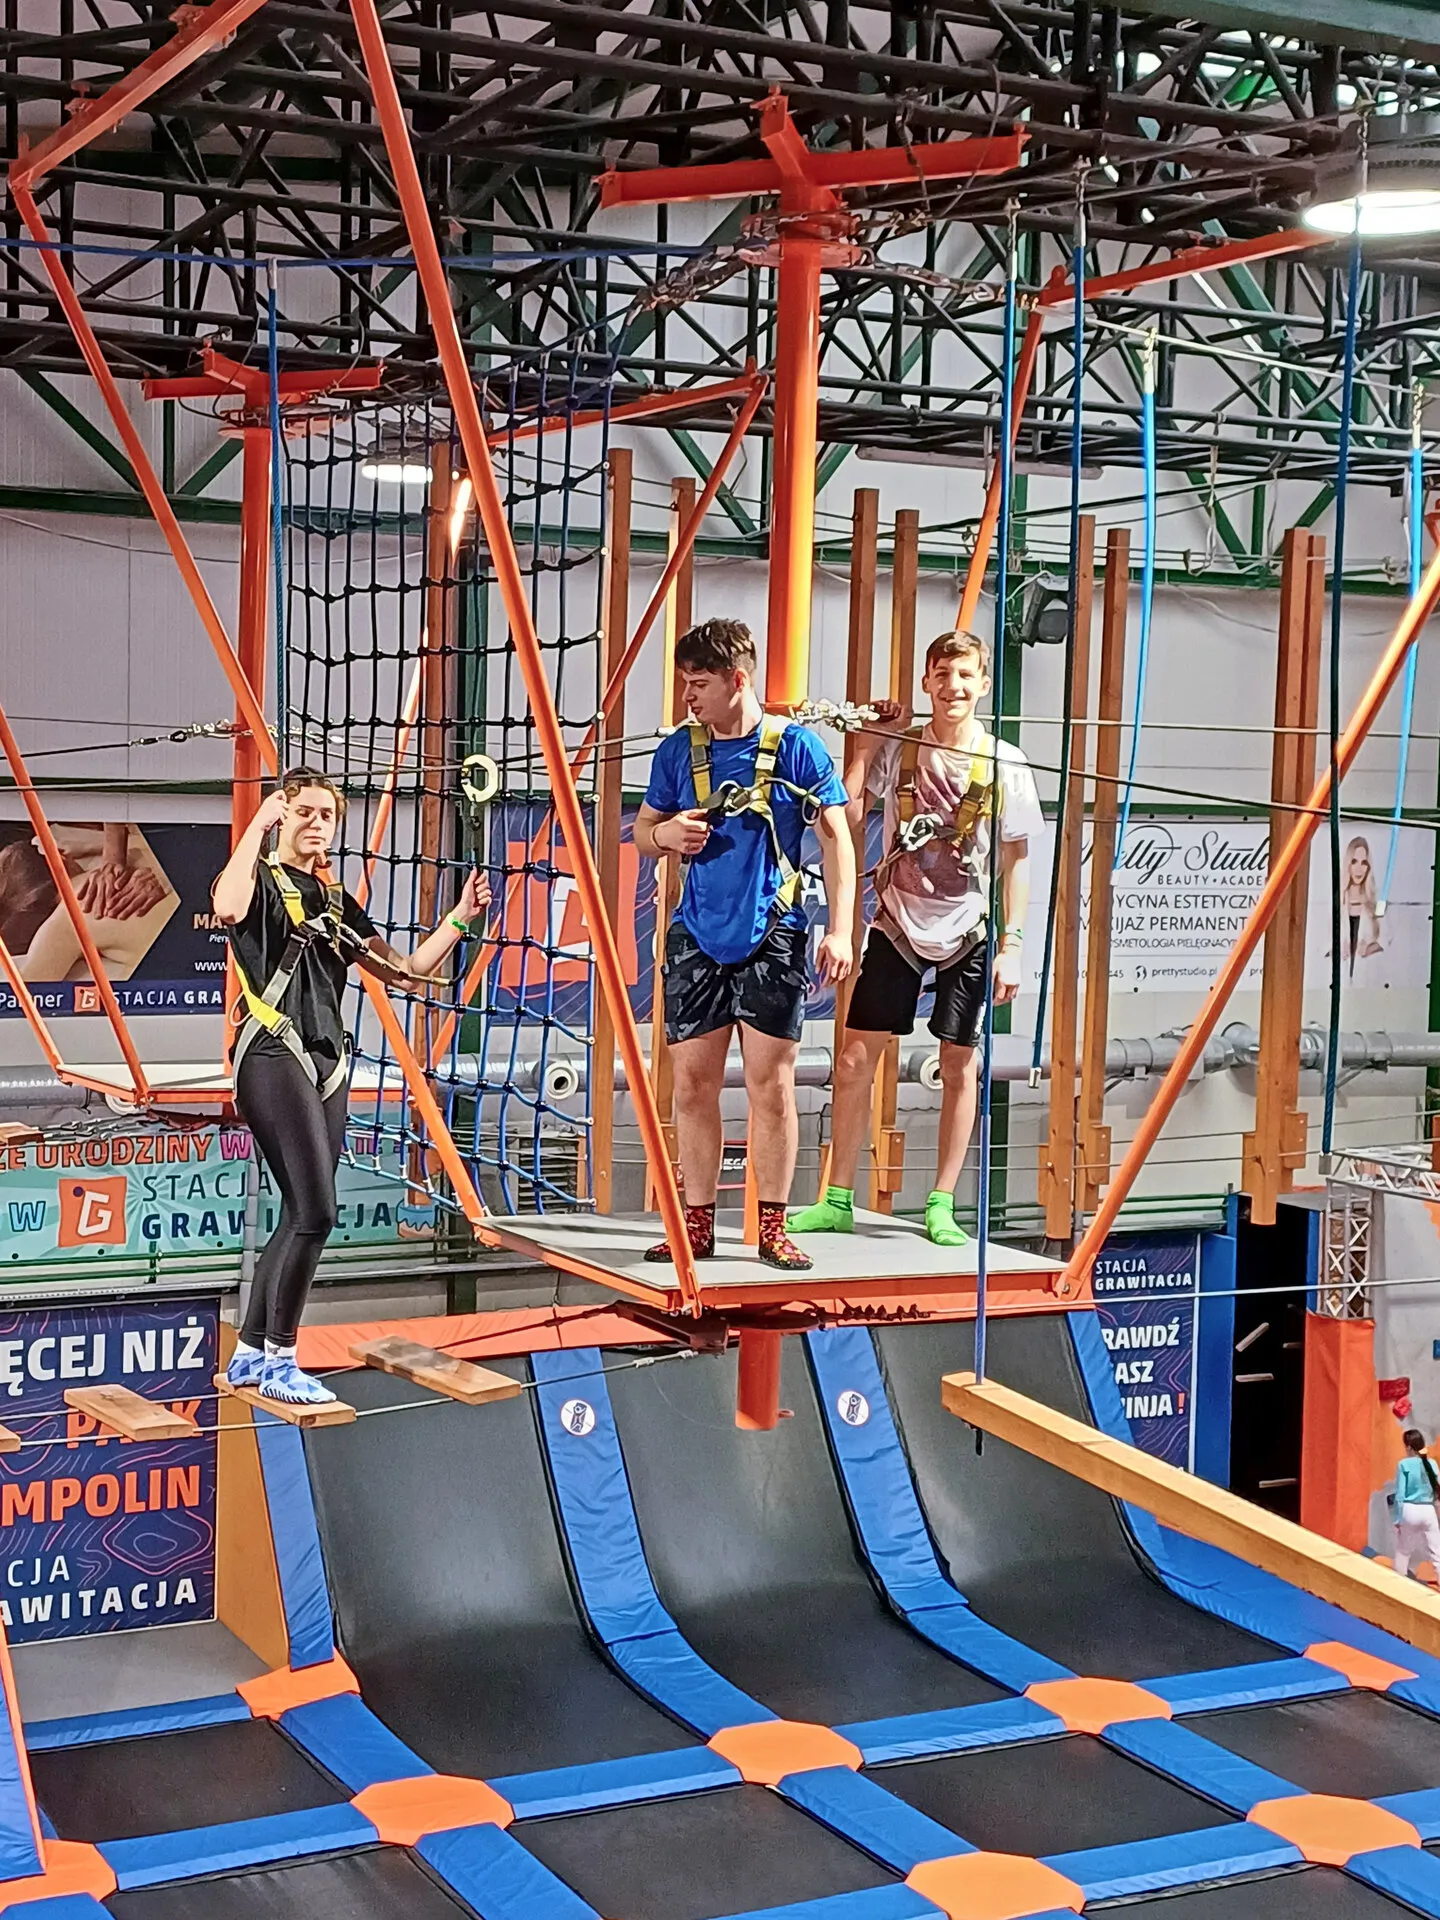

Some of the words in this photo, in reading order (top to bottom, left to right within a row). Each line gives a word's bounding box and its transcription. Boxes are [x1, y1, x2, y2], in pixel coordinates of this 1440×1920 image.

[1157, 873, 1209, 886] BEAUTY
[0, 992, 64, 1009] Paner
[36, 1132, 214, 1169] URODZINY
[142, 1171, 273, 1202] STACJA
[8, 1200, 46, 1232] W
[1095, 1272, 1193, 1291] GRAWITACJA
[1096, 1258, 1147, 1275] STACJA
[122, 1316, 206, 1374] NIŻ
[1115, 1360, 1155, 1385] ASZ
[1, 1465, 201, 1527] MPOLIN
[7, 1555, 71, 1588] CJA
